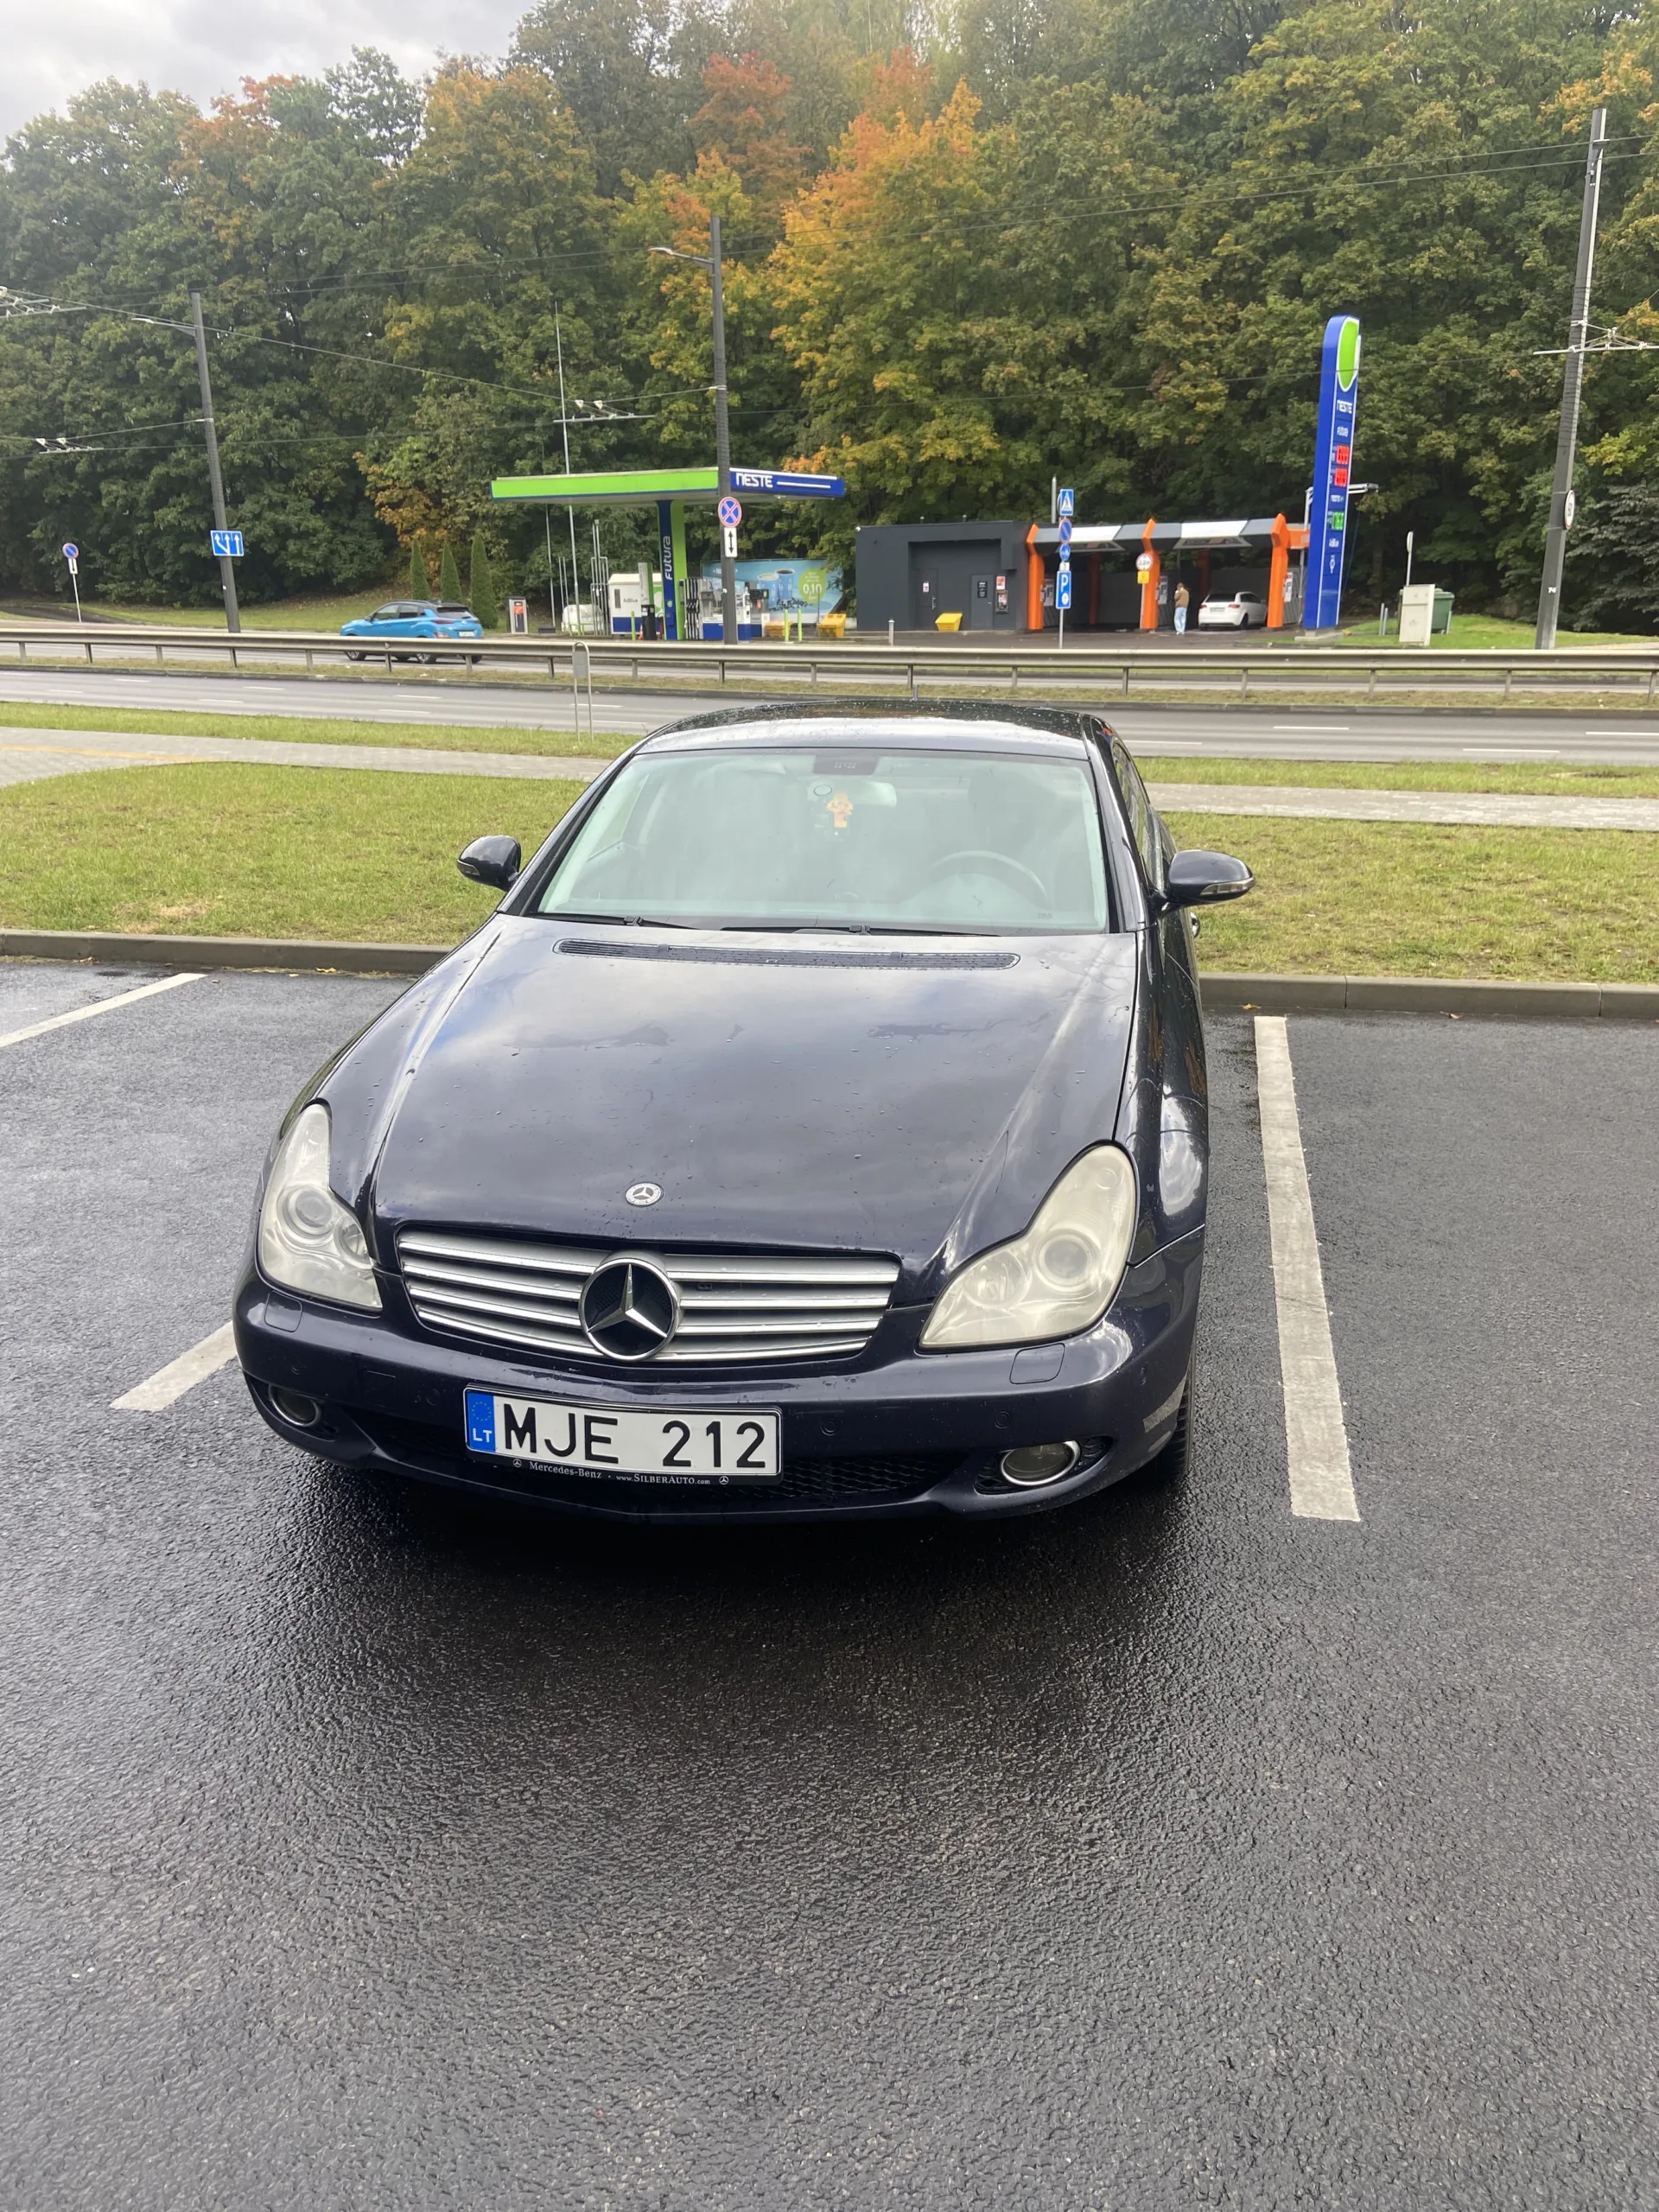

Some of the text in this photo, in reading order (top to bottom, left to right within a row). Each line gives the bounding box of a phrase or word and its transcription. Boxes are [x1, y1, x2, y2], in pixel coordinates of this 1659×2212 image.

[736, 473, 773, 487] NESTE
[1061, 574, 1068, 592] P
[473, 1427, 493, 1443] LT
[504, 1403, 766, 1468] MJE 212
[529, 1461, 602, 1479] Mercedes-Benz
